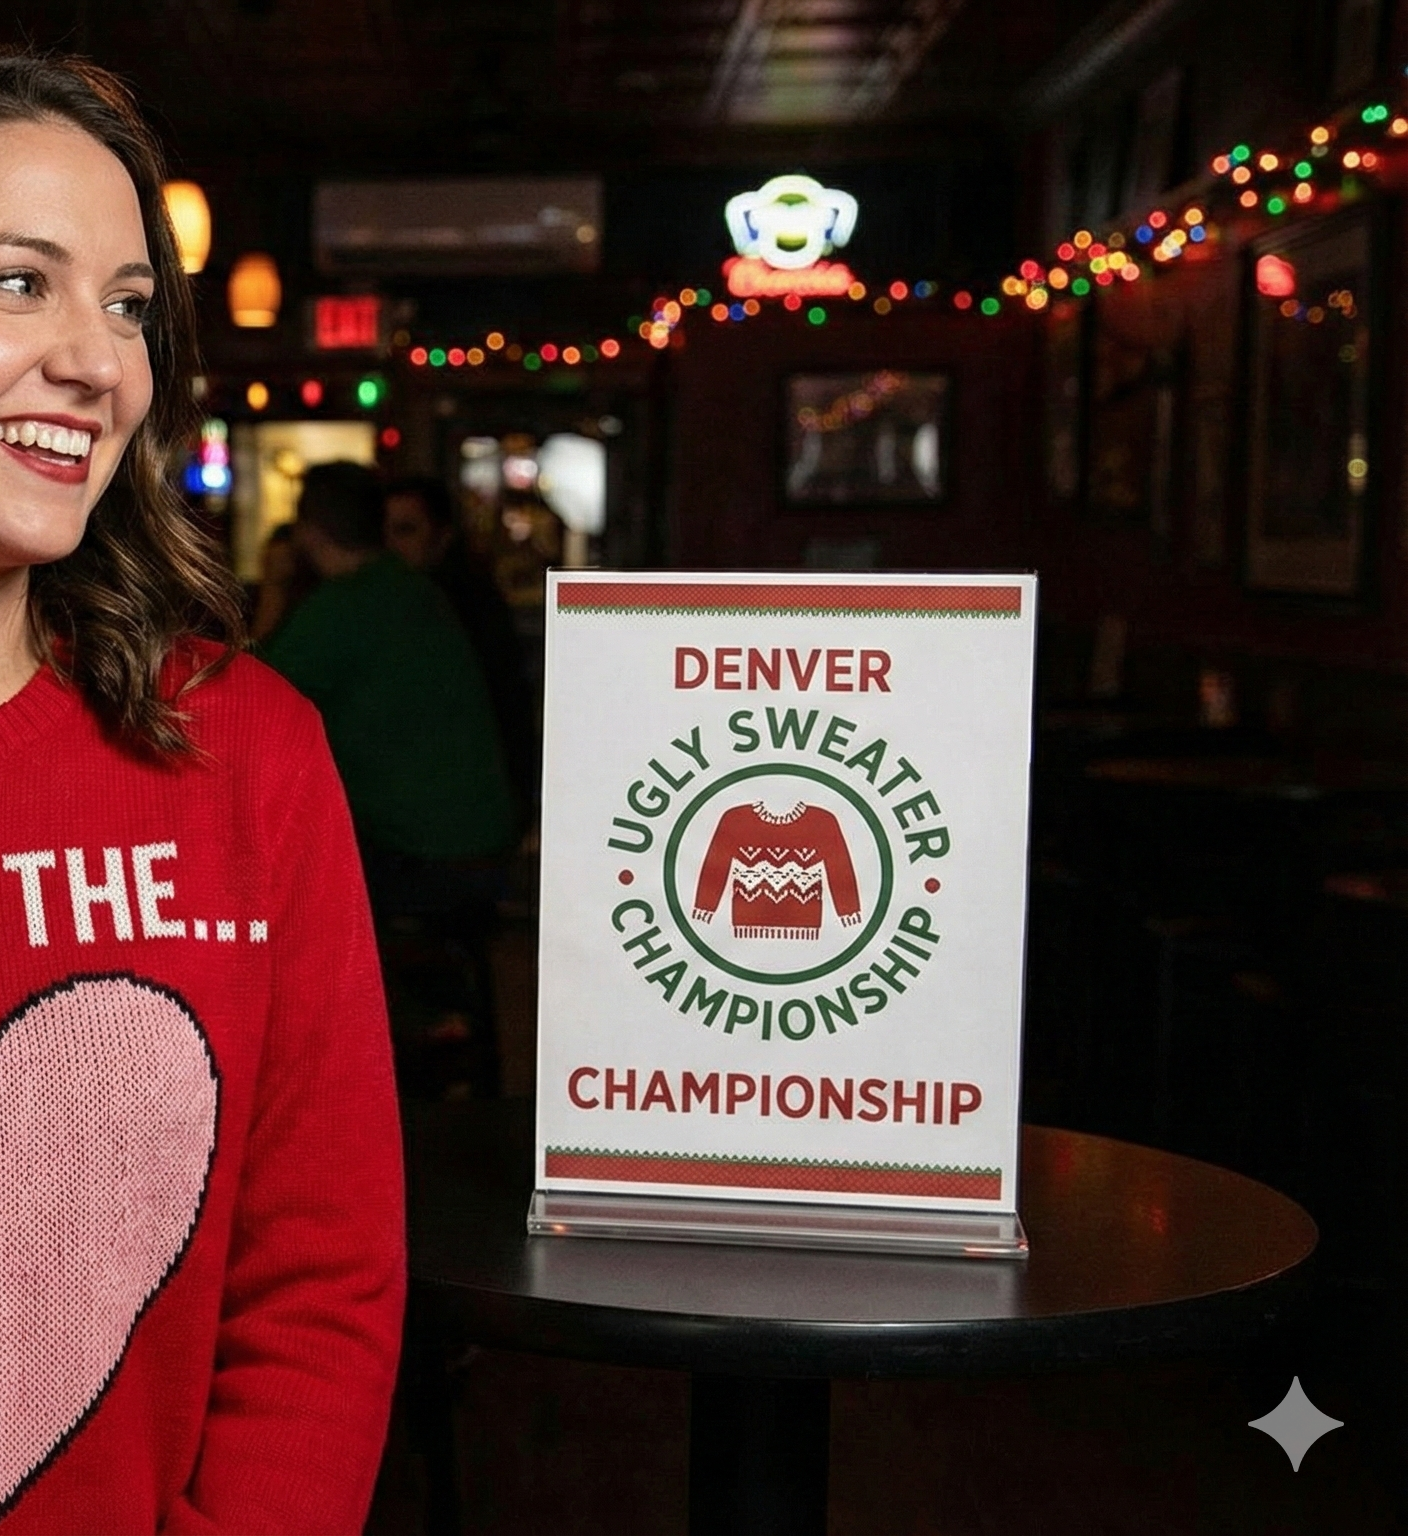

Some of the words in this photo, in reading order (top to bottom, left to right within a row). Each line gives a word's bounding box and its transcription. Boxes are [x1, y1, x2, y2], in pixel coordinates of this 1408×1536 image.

[673, 646, 892, 693] DENVER
[607, 726, 710, 854] UGLY
[728, 707, 951, 864] SWEATER
[1, 841, 269, 948] THE...
[611, 900, 942, 1041] CHAMPIONSHIP
[567, 1066, 983, 1125] CHAMPIONSHIP
